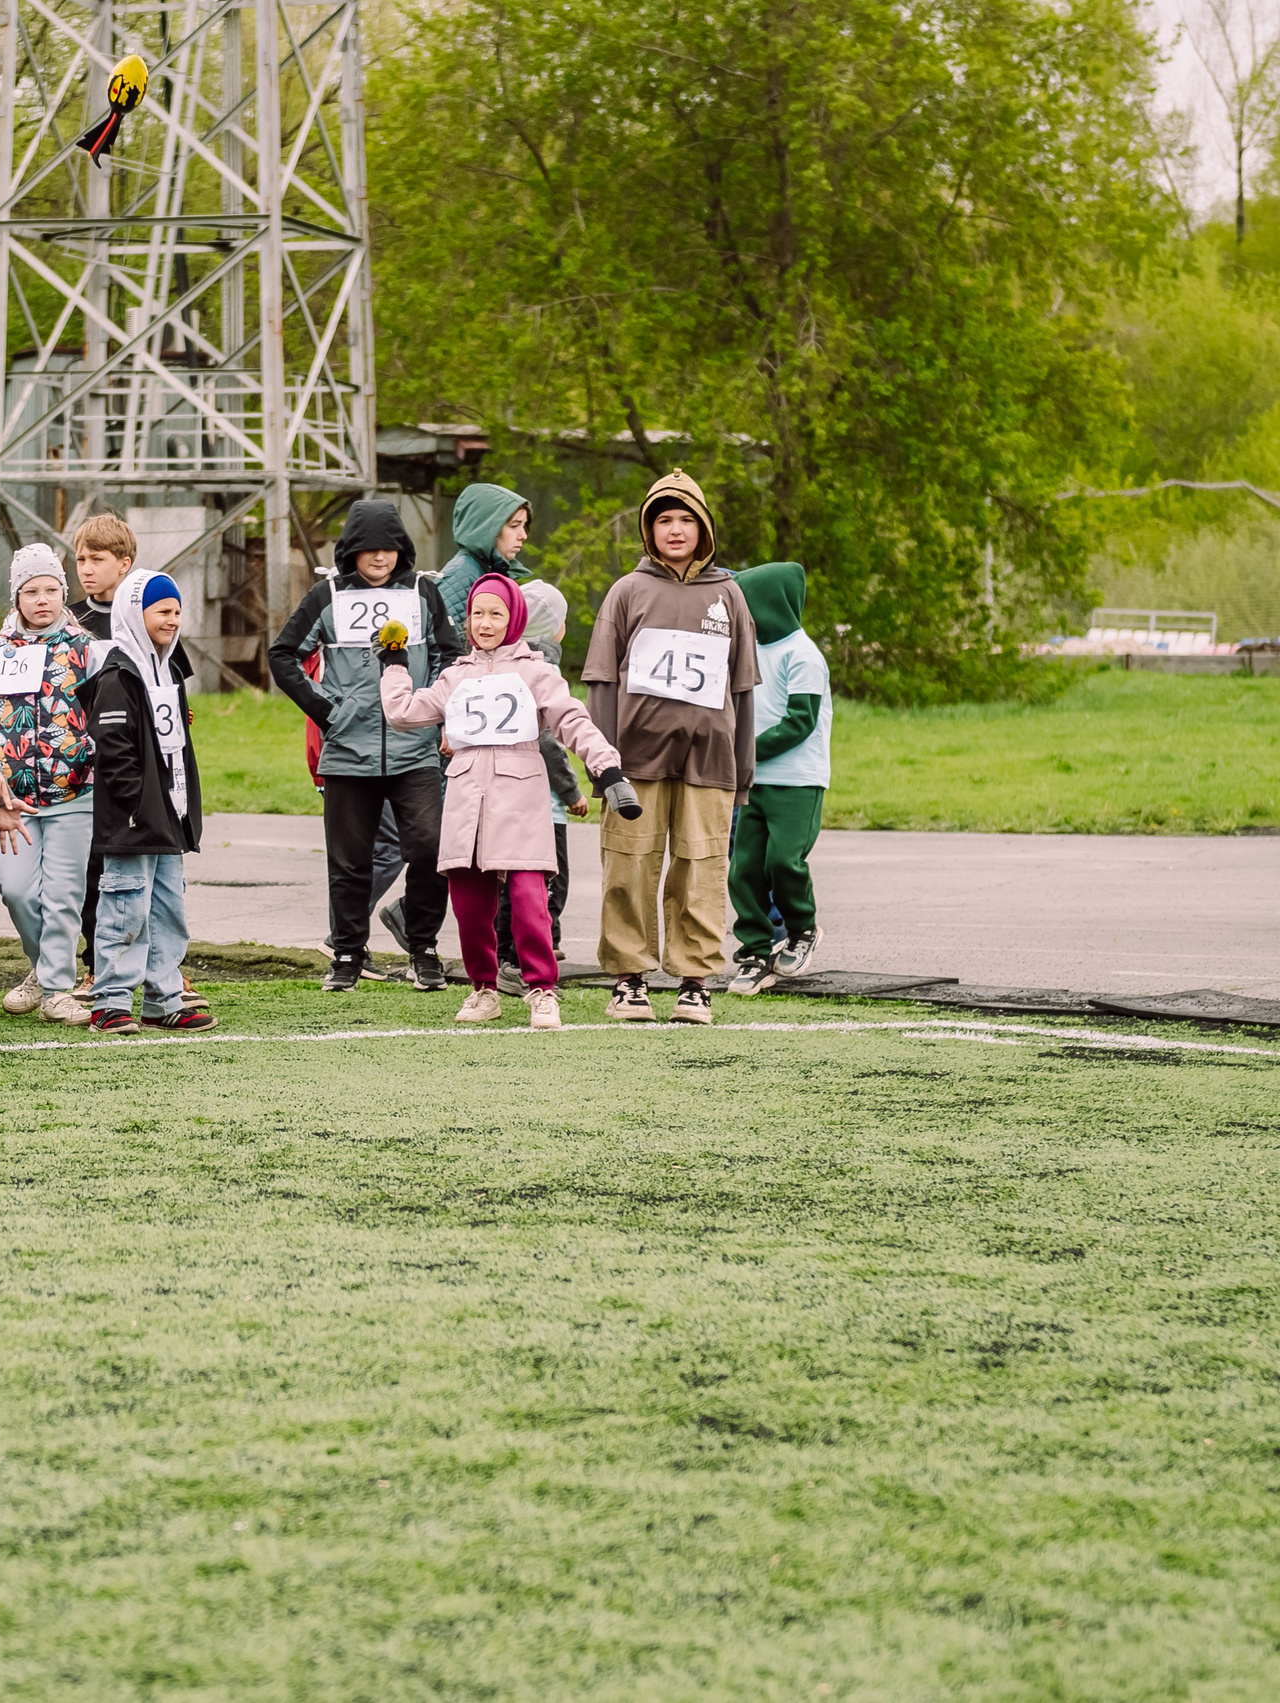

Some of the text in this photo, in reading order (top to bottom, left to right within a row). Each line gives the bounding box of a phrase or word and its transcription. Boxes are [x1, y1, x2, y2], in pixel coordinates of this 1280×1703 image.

[349, 602, 390, 630] 28
[0, 657, 28, 676] 126
[649, 650, 706, 692] 45
[464, 693, 519, 735] 52
